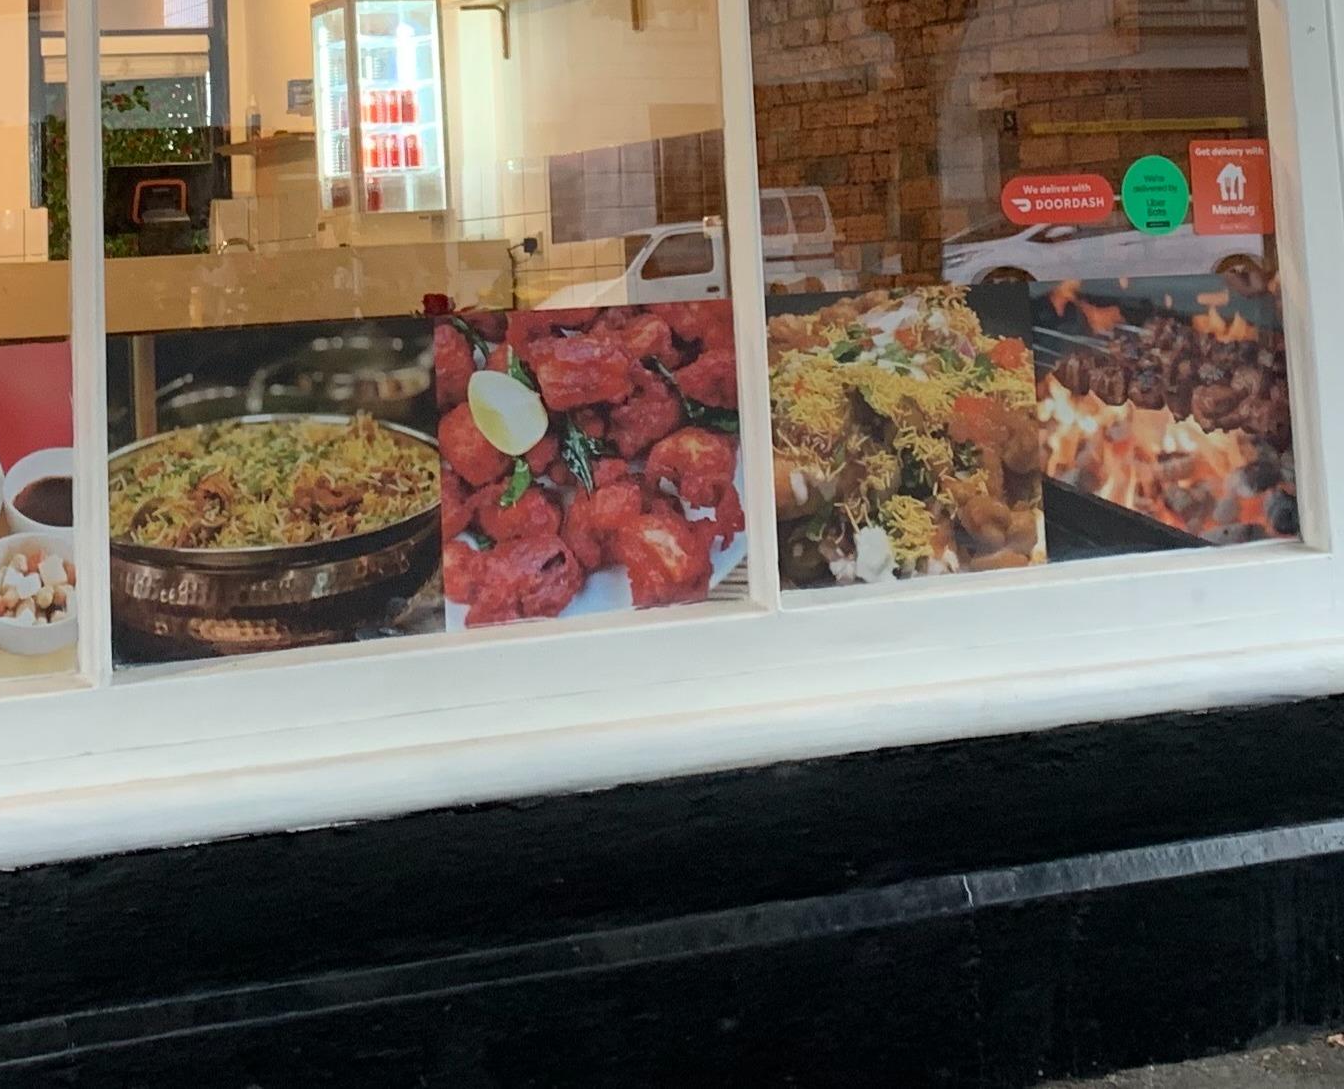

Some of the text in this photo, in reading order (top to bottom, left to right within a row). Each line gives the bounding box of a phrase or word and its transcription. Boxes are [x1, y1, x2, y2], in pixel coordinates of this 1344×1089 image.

[1195, 146, 1264, 158] Get delivery with
[1023, 183, 1092, 194] We deliver with
[1036, 197, 1104, 210] DOORDASH
[1212, 203, 1255, 217] Menulog
